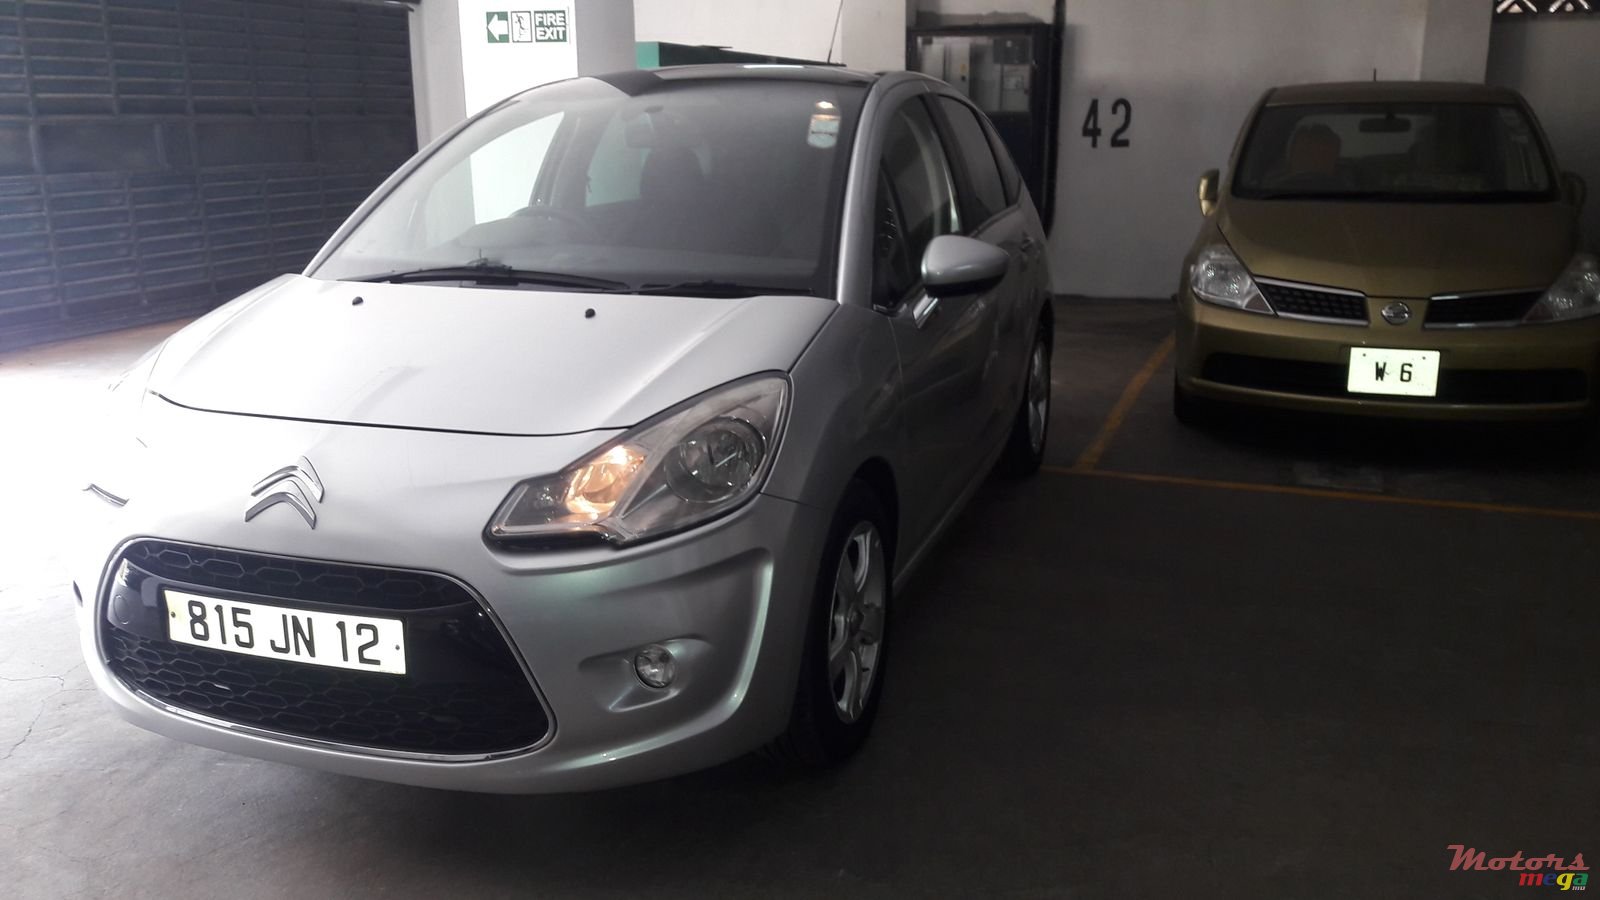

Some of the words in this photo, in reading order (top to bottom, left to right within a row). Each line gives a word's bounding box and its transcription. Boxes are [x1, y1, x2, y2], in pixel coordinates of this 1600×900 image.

[535, 12, 565, 26] FIRE
[536, 26, 566, 40] EXIT
[1082, 98, 1131, 148] 42
[1375, 361, 1387, 381] W
[1400, 363, 1413, 382] 6
[188, 600, 254, 649] 815
[270, 614, 316, 658] JN
[336, 621, 381, 665] 12
